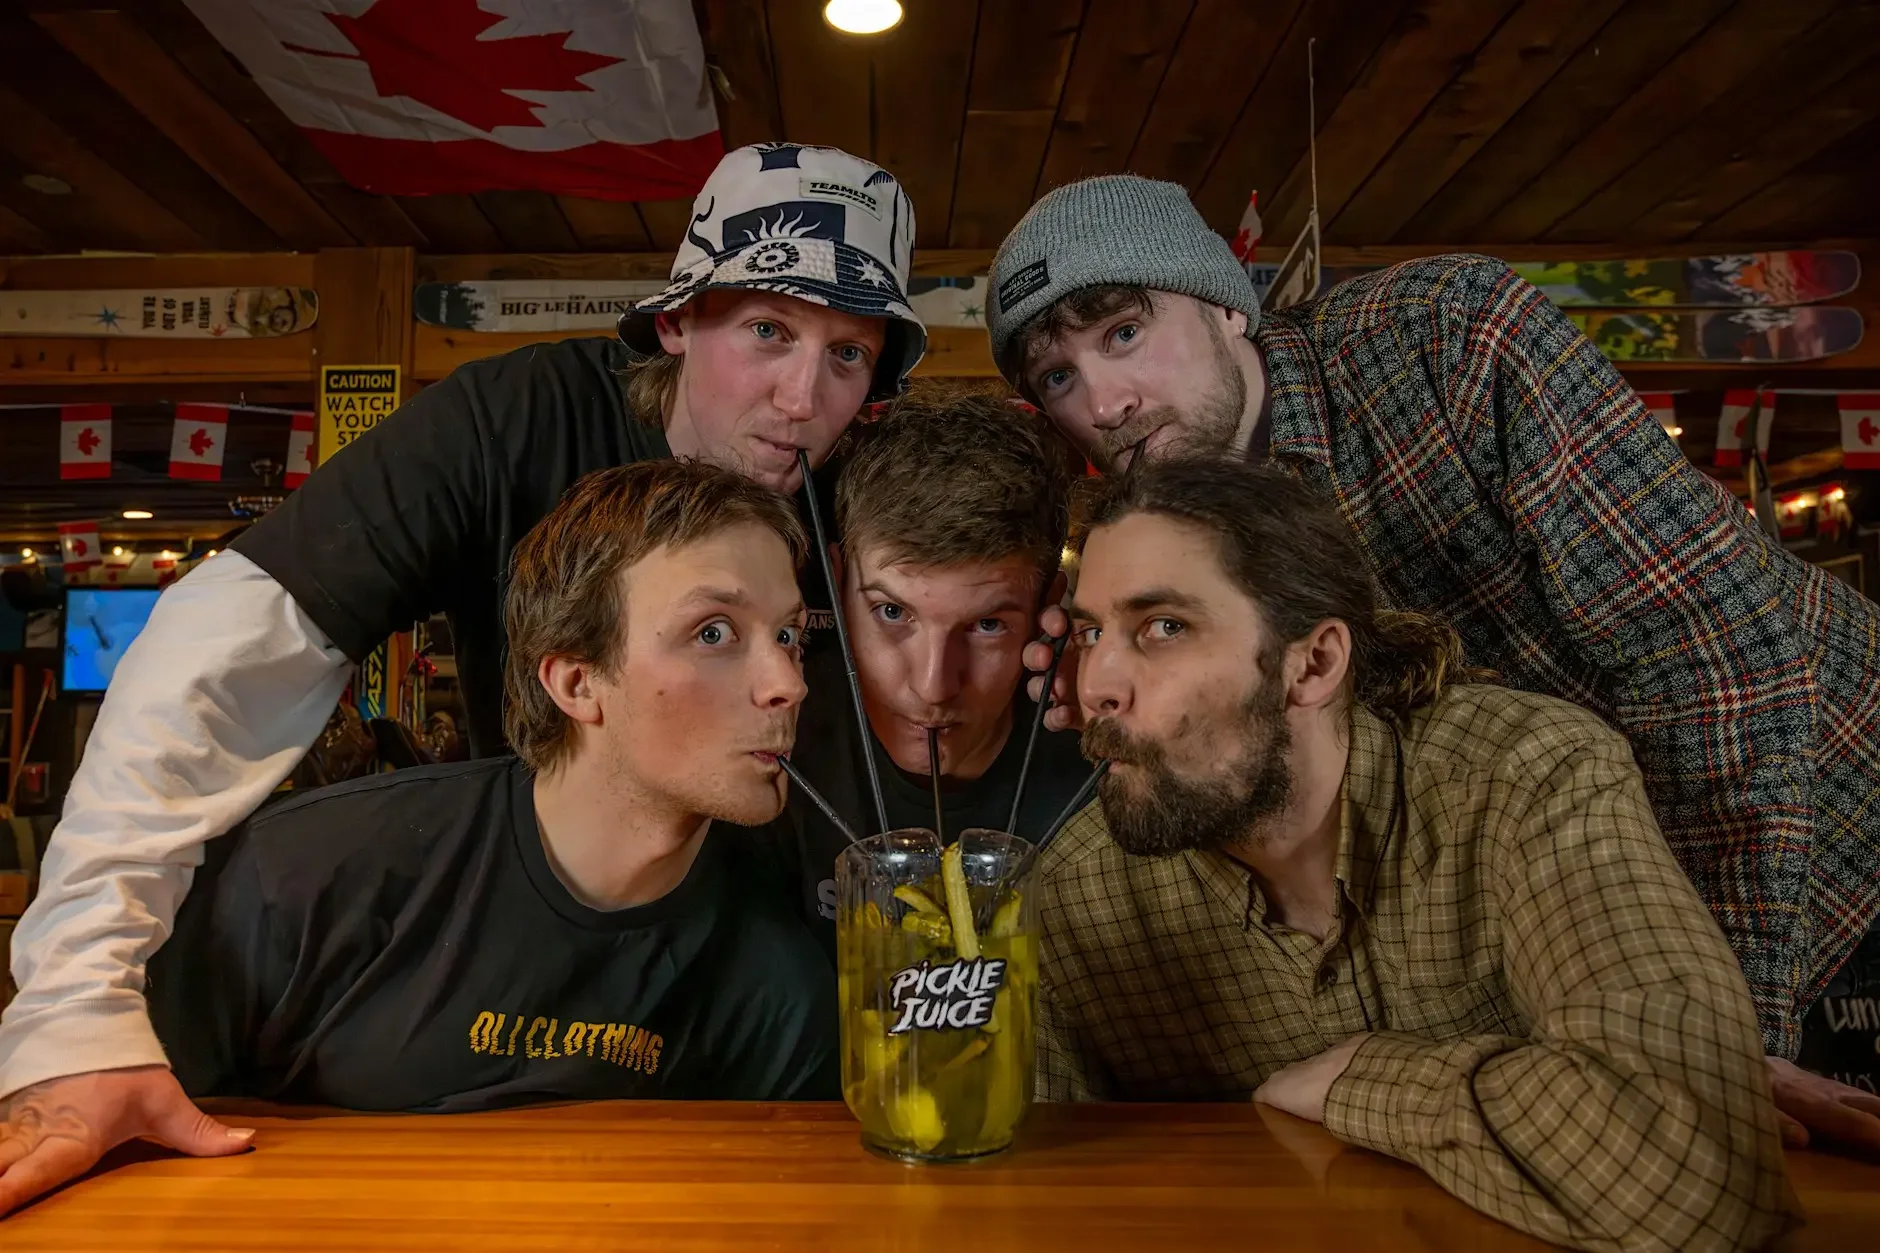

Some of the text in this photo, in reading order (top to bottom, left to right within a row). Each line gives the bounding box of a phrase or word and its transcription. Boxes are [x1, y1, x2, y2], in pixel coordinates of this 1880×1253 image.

[810, 182, 877, 206] TEAMLTD
[1024, 266, 1044, 281] GOODS
[162, 312, 176, 330] OUT
[329, 374, 392, 389] CAUTION
[326, 396, 394, 412] WATCH
[524, 1016, 664, 1075] CLOTHING
